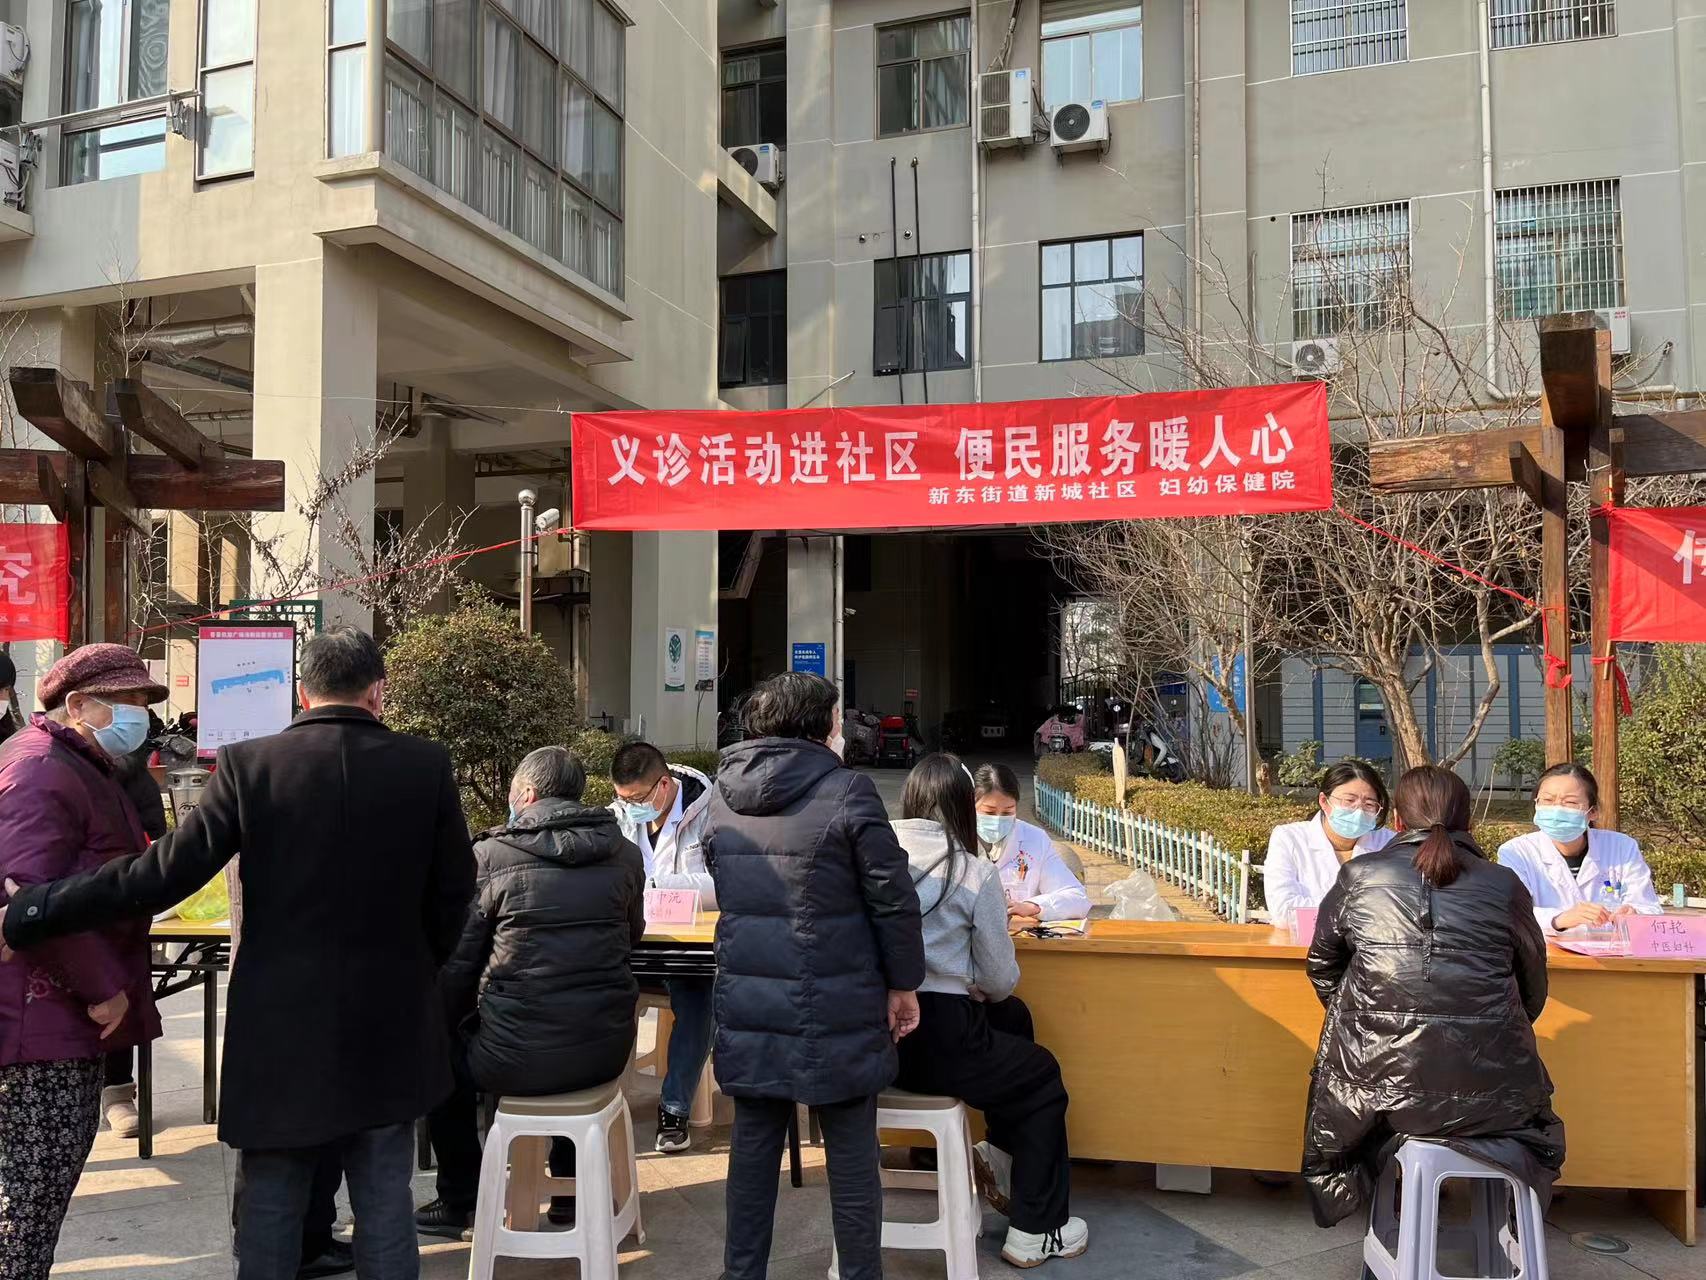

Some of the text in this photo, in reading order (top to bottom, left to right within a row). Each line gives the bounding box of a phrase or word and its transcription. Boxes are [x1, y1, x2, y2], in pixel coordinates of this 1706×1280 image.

[606, 411, 1296, 487] 义诊活动进社区 便民服务暖人心
[927, 469, 1297, 505] 新东街道新城社区 妇幼保健院
